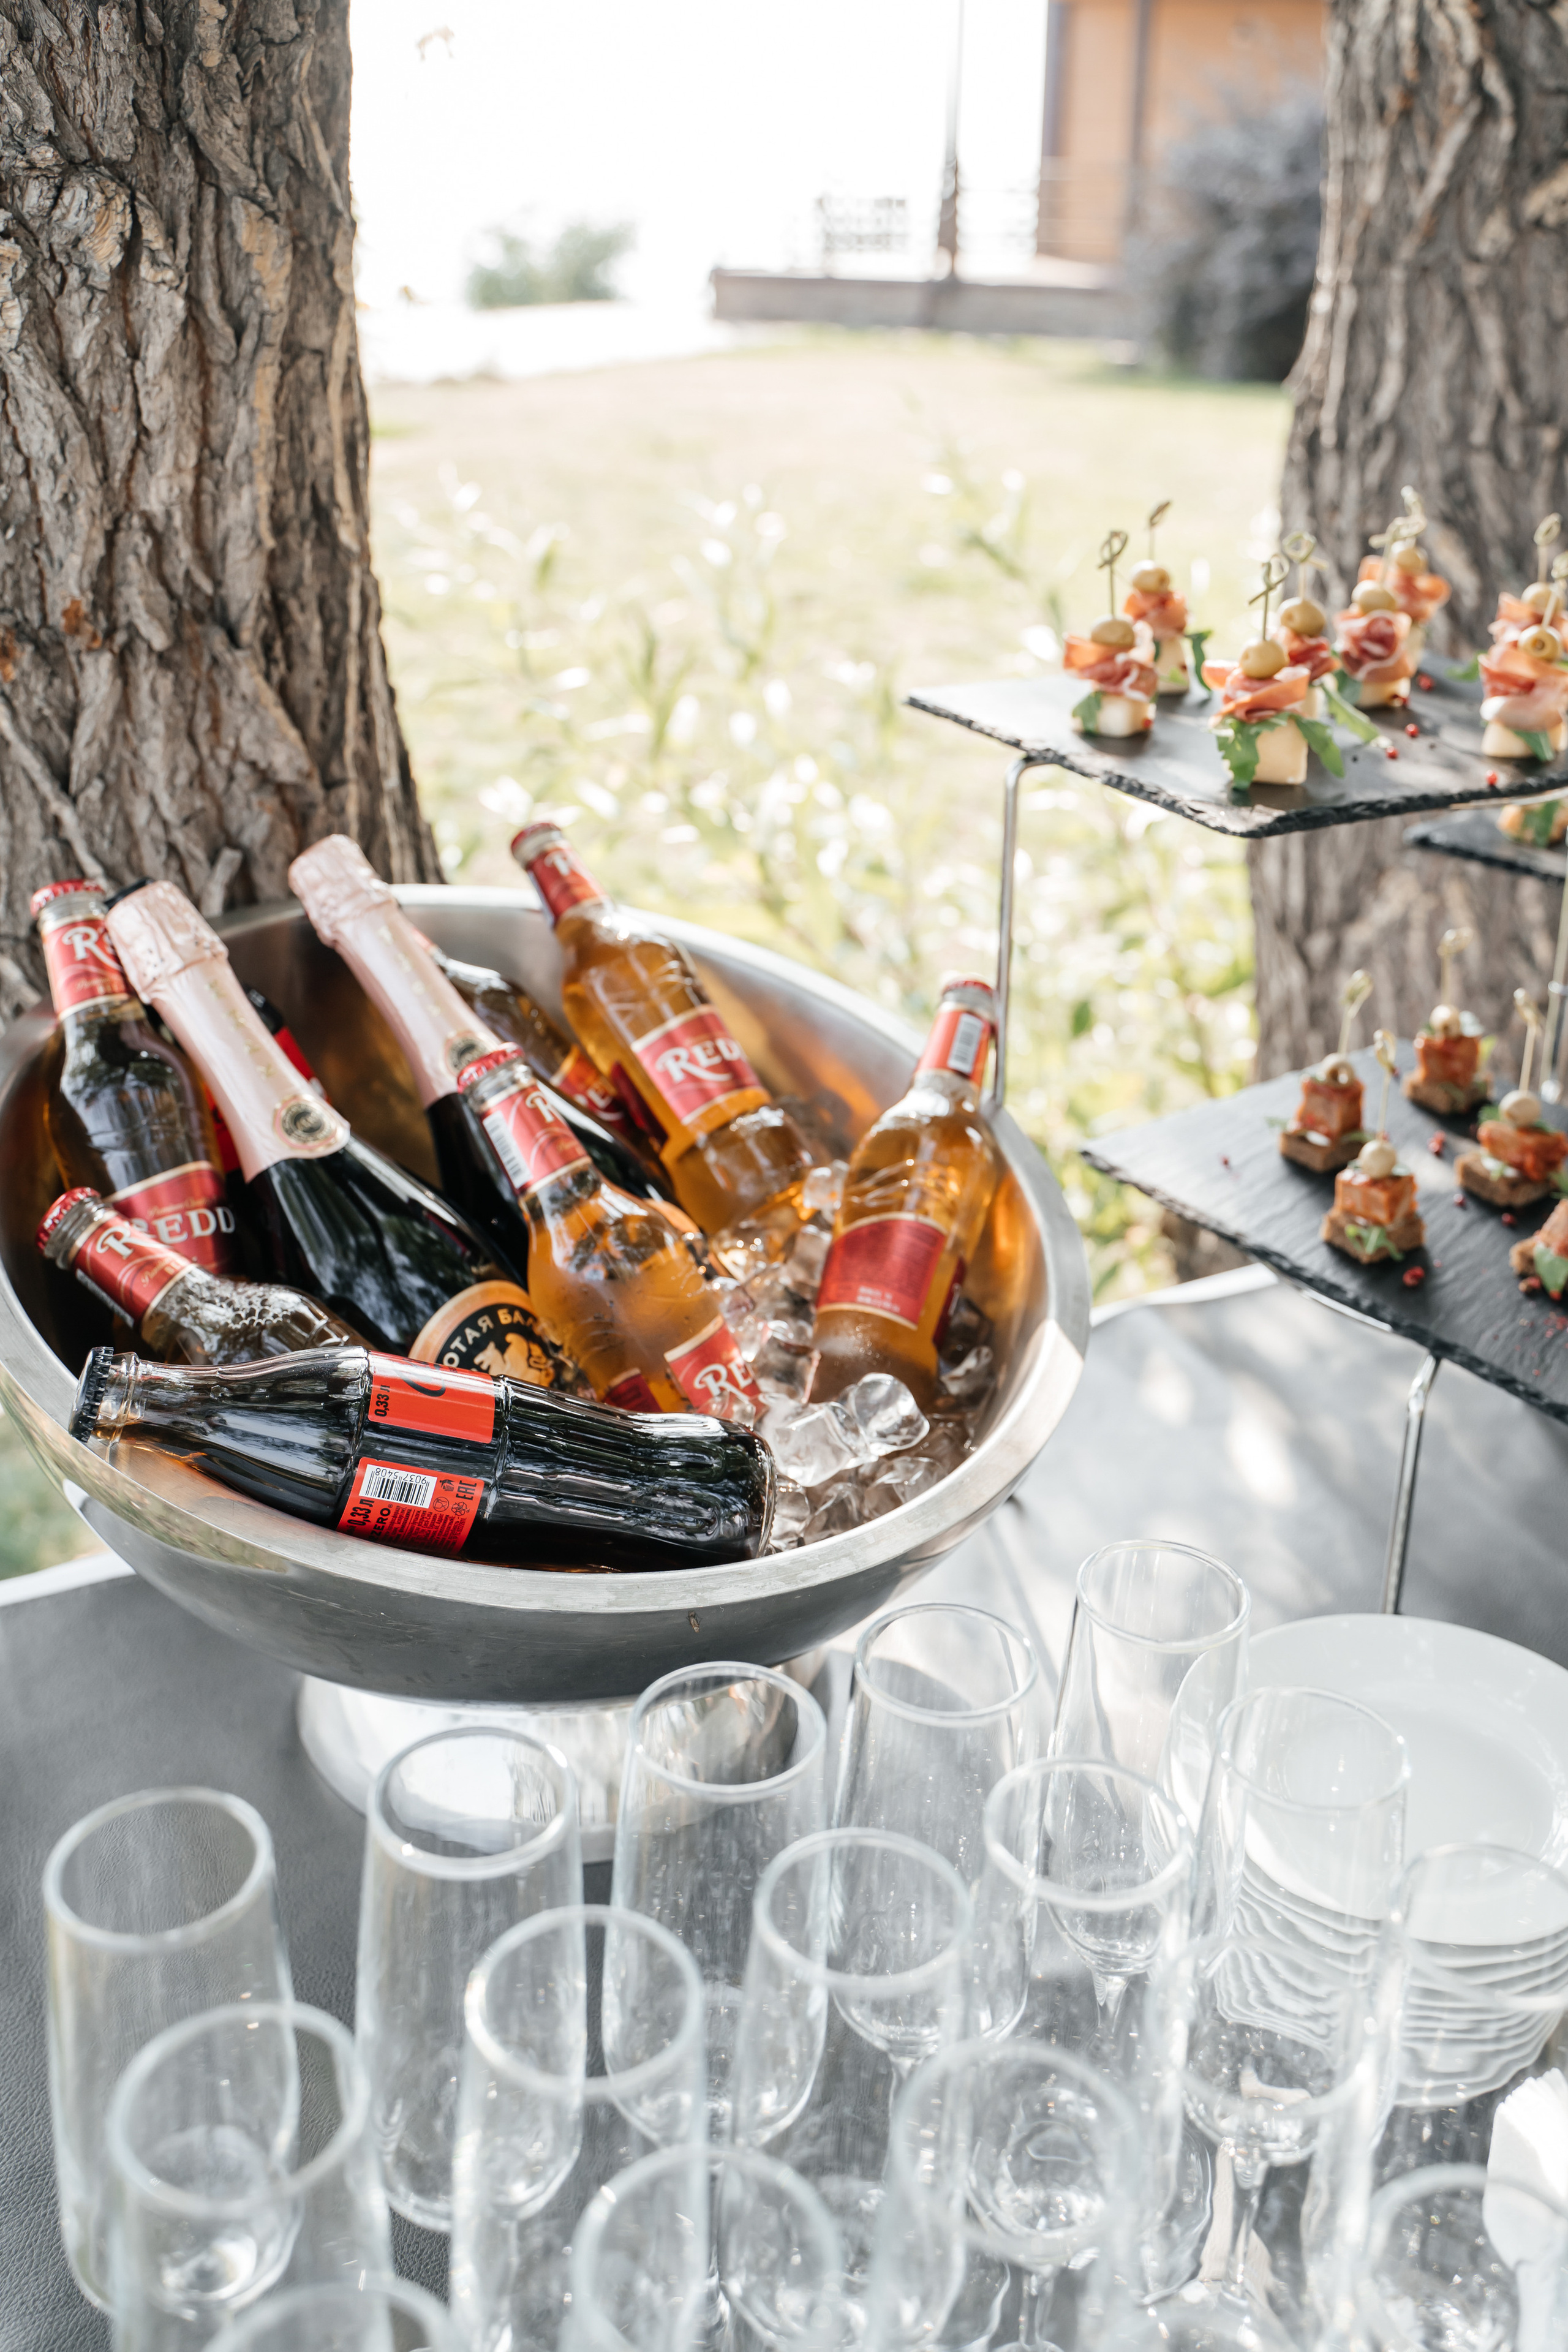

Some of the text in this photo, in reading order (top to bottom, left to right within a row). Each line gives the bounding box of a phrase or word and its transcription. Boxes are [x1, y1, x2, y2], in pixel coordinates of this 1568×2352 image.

[443, 1315, 494, 1368] ОТАЯ
[374, 1393, 390, 1417] 0,33
[375, 1467, 427, 1485] 9037 5408
[347, 1506, 372, 1526] 0,33
